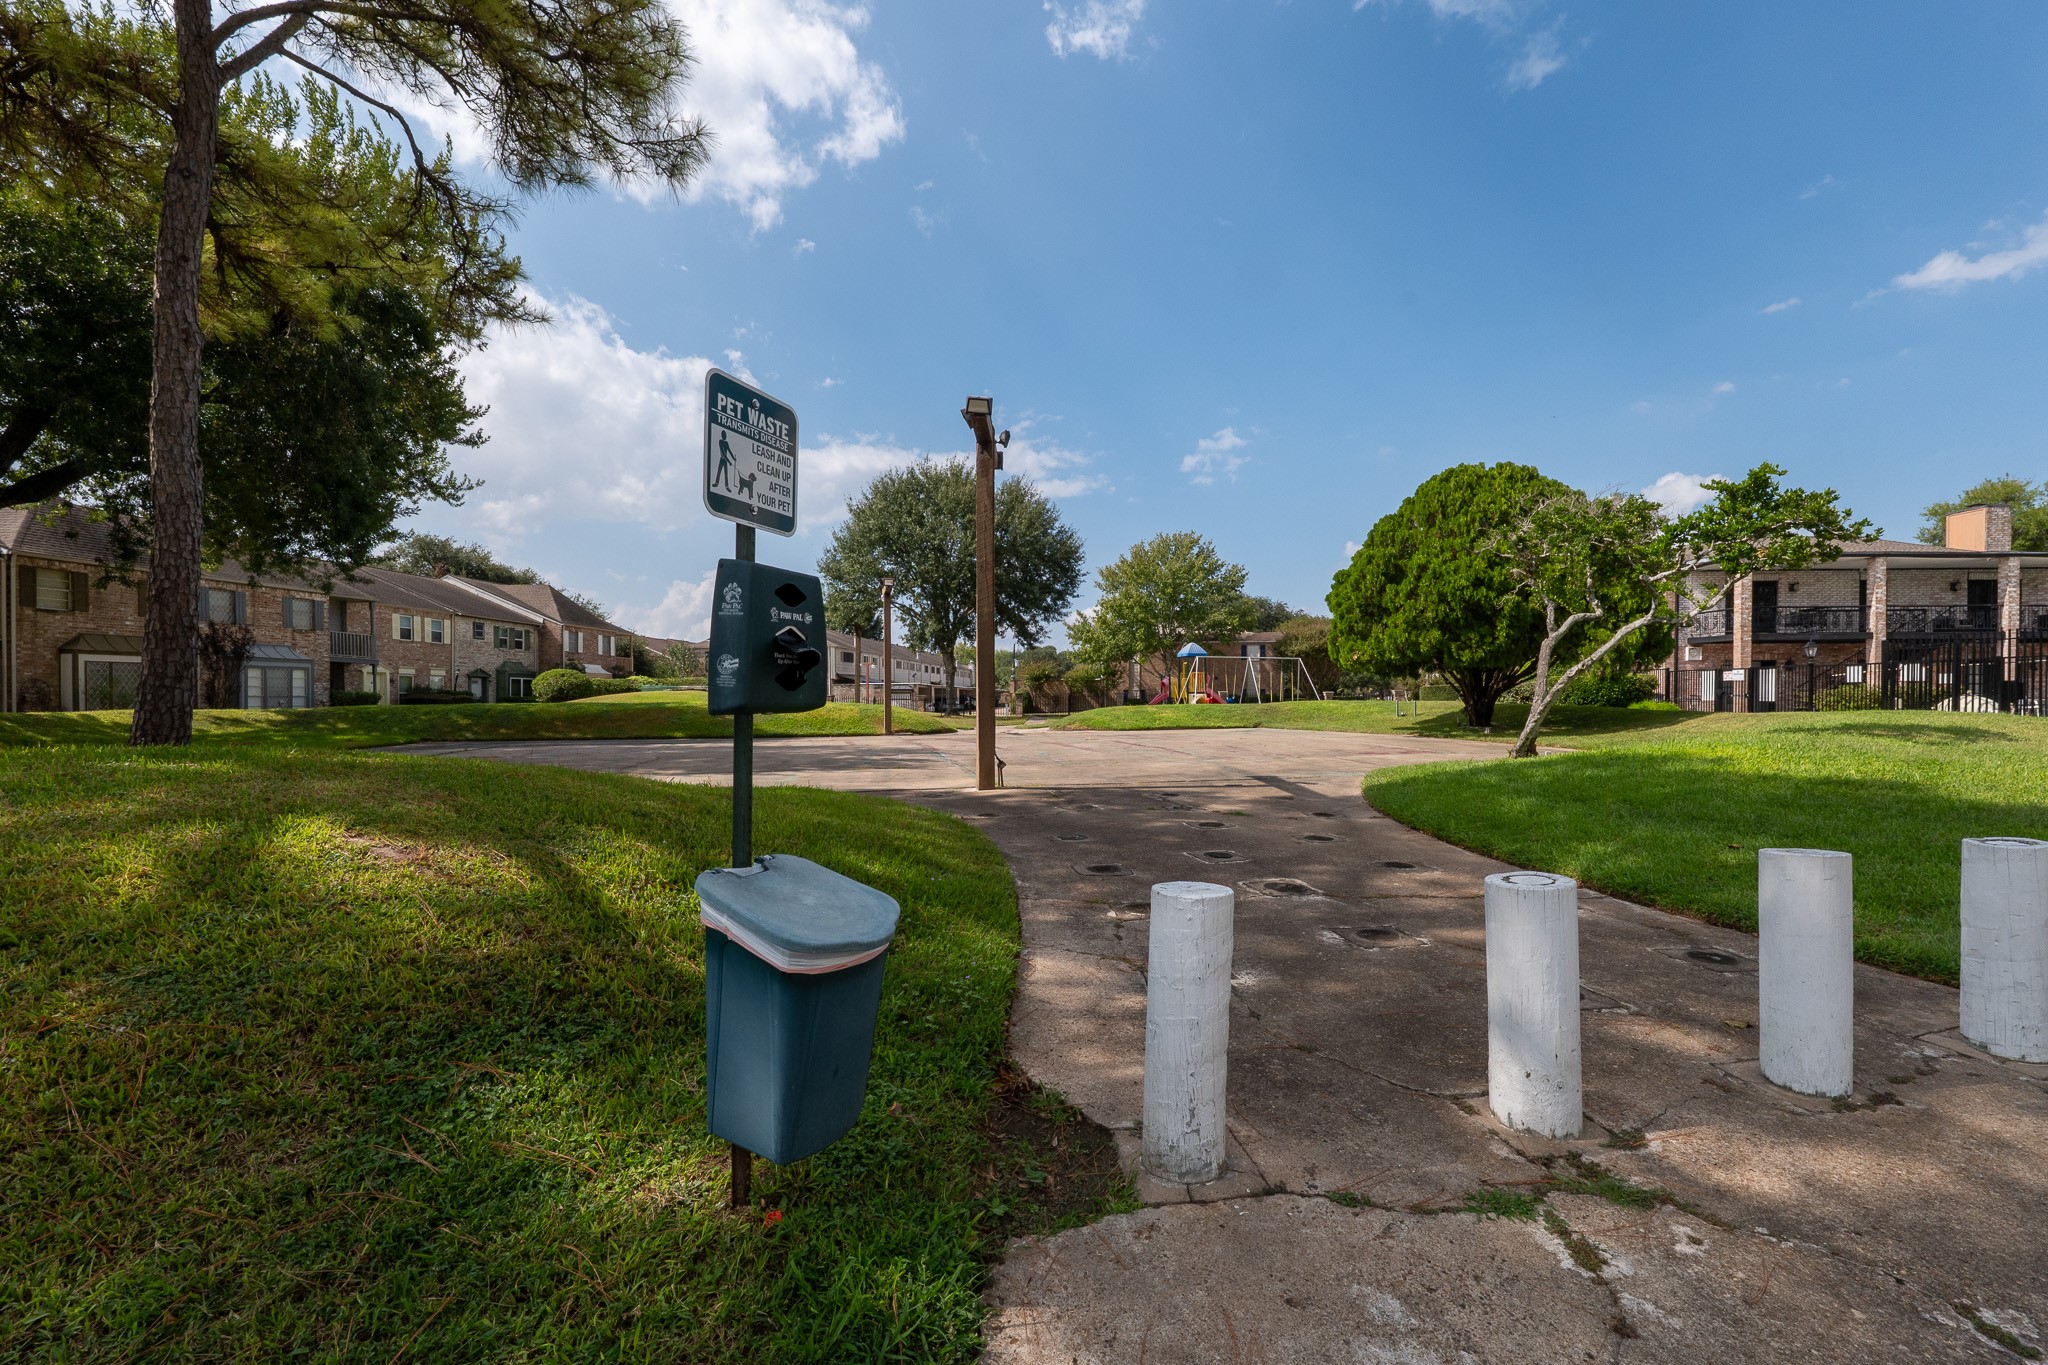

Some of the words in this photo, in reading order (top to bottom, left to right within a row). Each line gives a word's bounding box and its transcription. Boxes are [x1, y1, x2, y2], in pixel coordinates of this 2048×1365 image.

[717, 392, 744, 420] PET
[747, 406, 789, 441] WASTE
[717, 412, 759, 438] TRANSMITS
[760, 429, 789, 452] DISEASE
[751, 442, 776, 460] LEASH
[776, 452, 791, 468] AND
[756, 461, 780, 479] CLEAN
[781, 468, 791, 482] UP
[768, 481, 791, 498] AFTER
[756, 491, 776, 509] YOUR
[777, 499, 790, 513] PET
[779, 611, 792, 620] PAW
[792, 613, 803, 622] PAL
